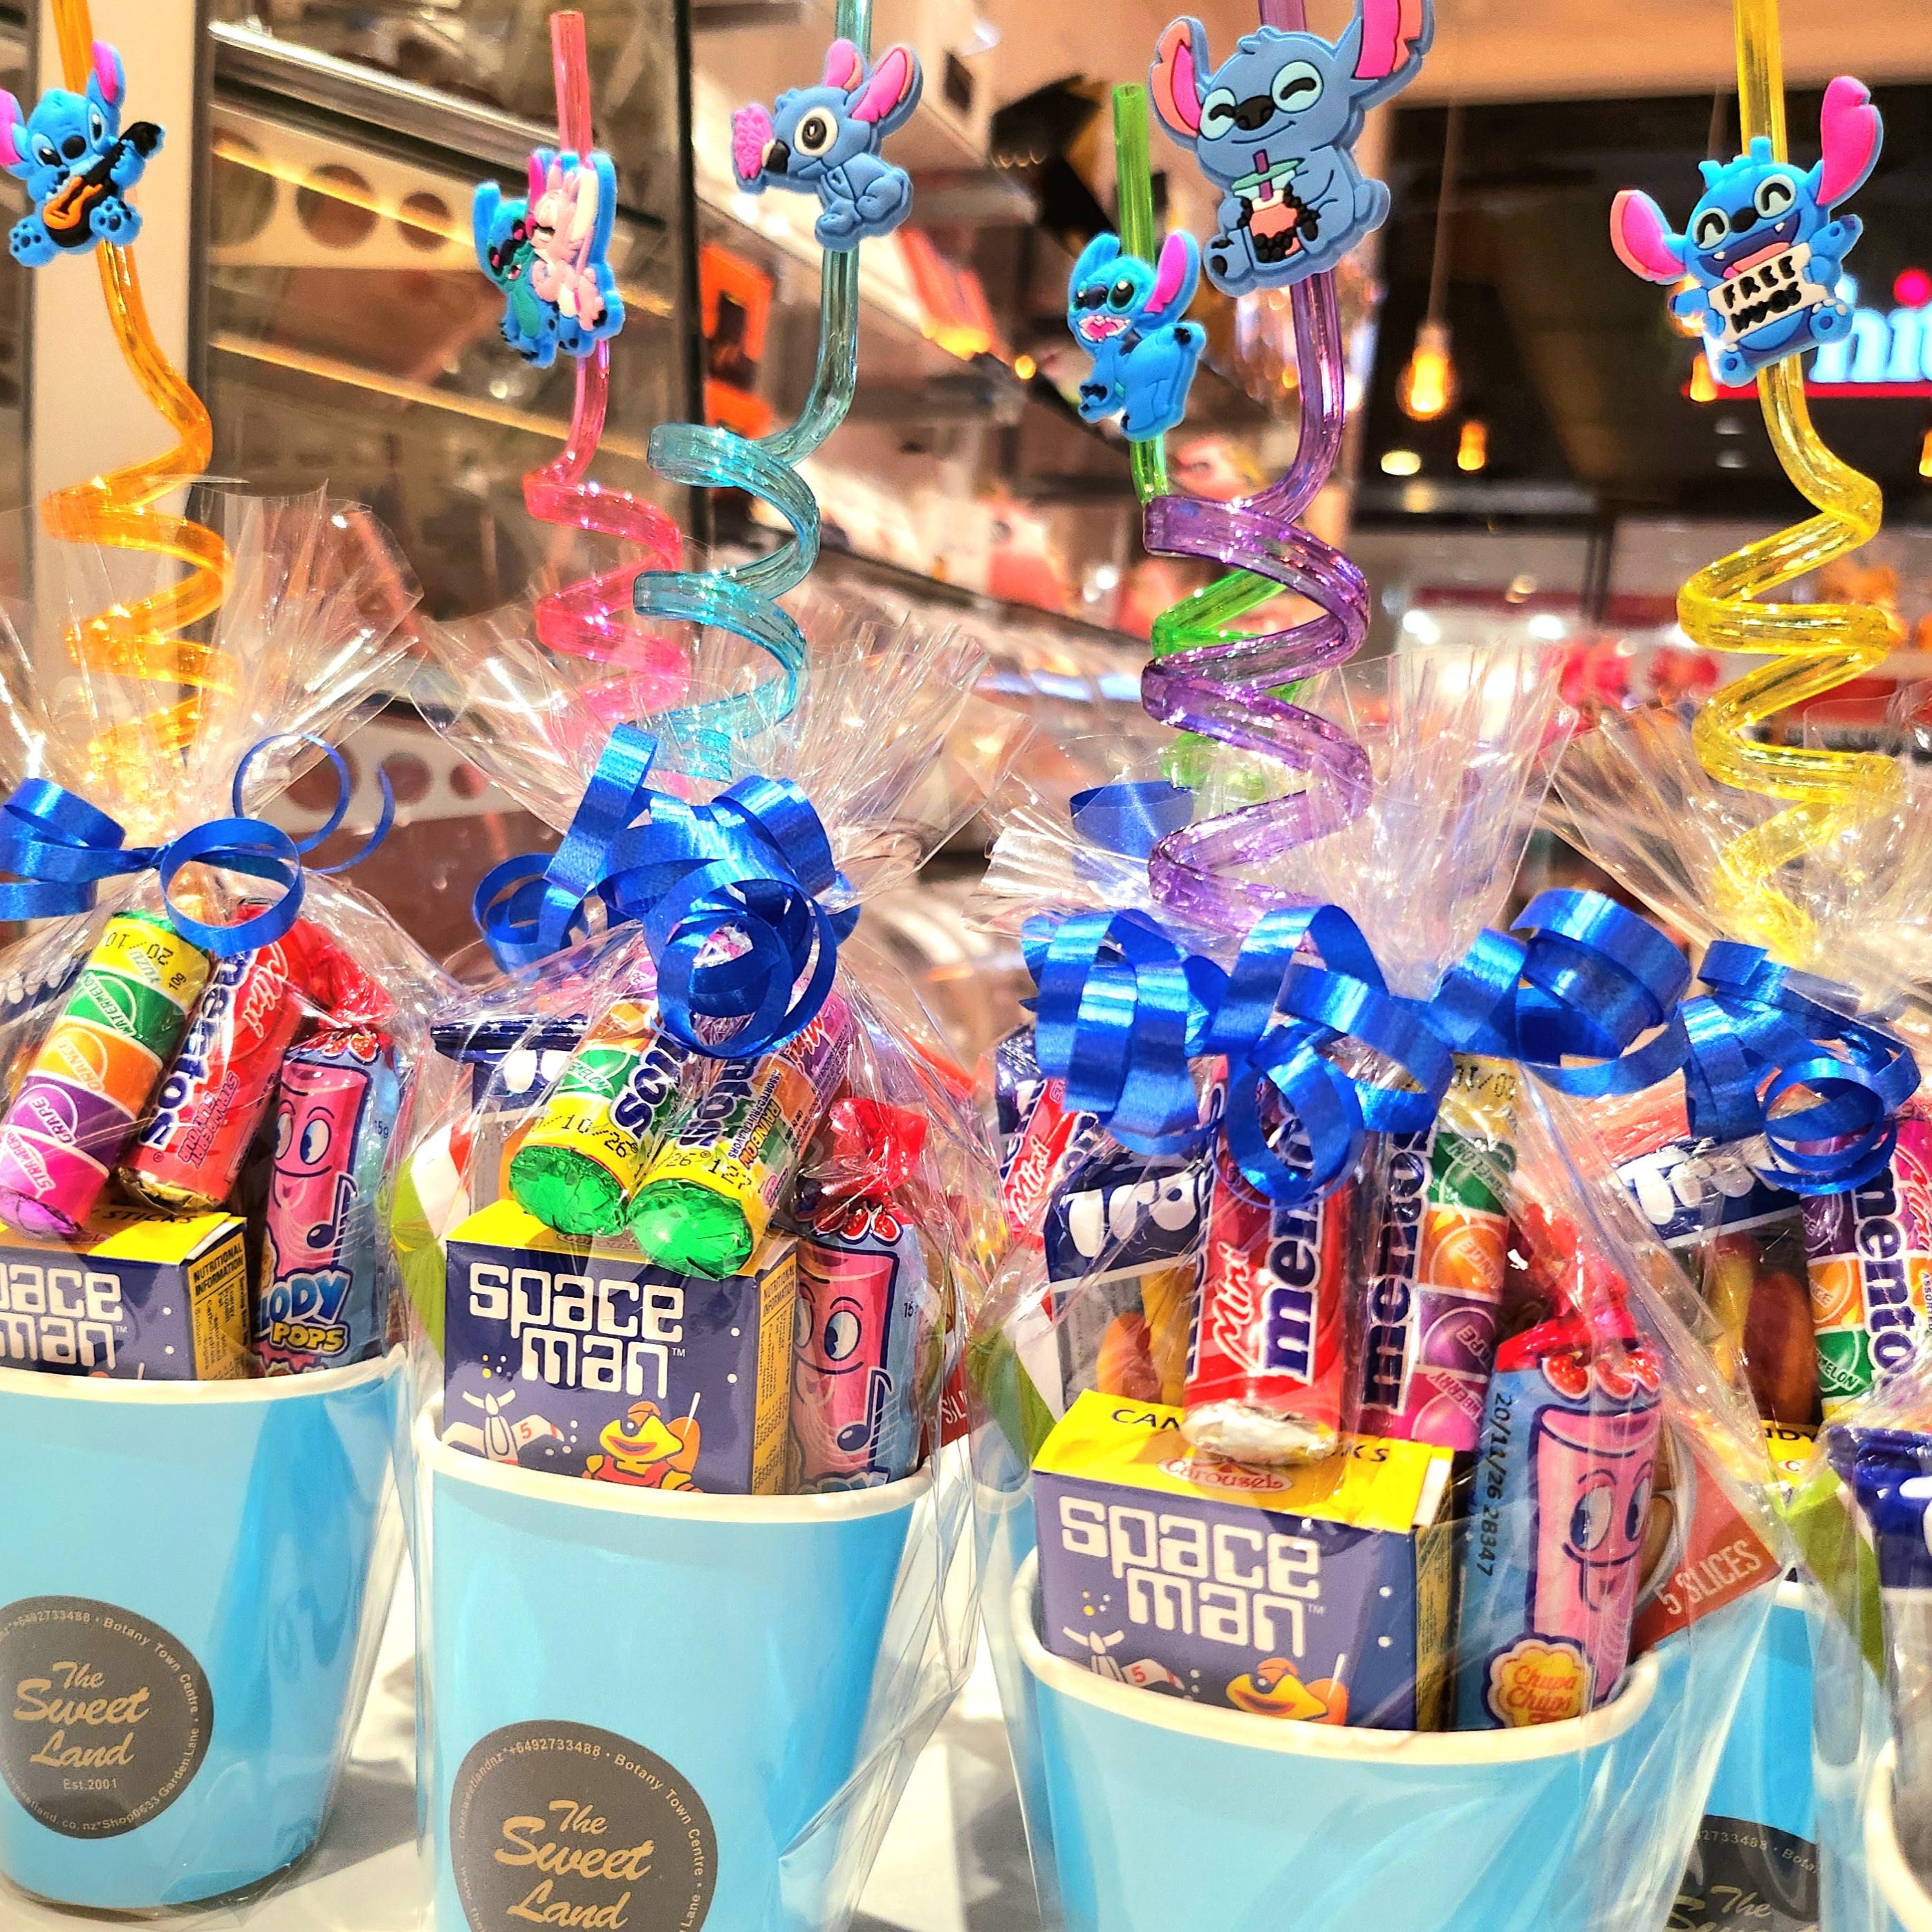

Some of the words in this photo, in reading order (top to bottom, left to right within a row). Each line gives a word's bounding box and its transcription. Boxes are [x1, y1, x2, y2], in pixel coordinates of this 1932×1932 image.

[1724, 254, 1794, 309] FREE
[1730, 281, 1802, 334] HUGS
[128, 949, 161, 984] YUZU
[167, 972, 187, 991] 10g
[757, 1069, 782, 1108] ASSORTED
[32, 1097, 74, 1144] GRAPE
[178, 1092, 219, 1163] FLAVOUR
[189, 1070, 241, 1169] STRAWBERRY
[739, 1098, 782, 1170] RAINBOW
[727, 1122, 753, 1160] FLAVORS
[1010, 1134, 1050, 1226] Mini
[104, 1210, 194, 1225] STICKS
[194, 1243, 243, 1283] NUTRITIONAL
[195, 1255, 244, 1297] INFORMATION
[763, 1264, 795, 1302] NUTRITIONAL
[1261, 1151, 1326, 1386] men
[1852, 1166, 1915, 1385] mento
[0, 1263, 123, 1321] ace
[470, 1262, 685, 1343] space
[763, 1281, 796, 1316] INFORMATION
[1212, 1241, 1262, 1377] Mini
[272, 1323, 345, 1351] POPS
[521, 1327, 669, 1399] man
[520, 1422, 532, 1439] 5
[1111, 1408, 1182, 1432] CAN
[1485, 1392, 1513, 1500] 20/11/26
[1165, 1456, 1285, 1490] Carousel
[1059, 1495, 1321, 1599] space
[1654, 1581, 1682, 1616] 5
[1674, 1539, 1763, 1604] SLICES
[1126, 1567, 1304, 1657] man
[52, 1661, 105, 1689] The
[104, 1617, 151, 1646] Botany
[154, 1642, 181, 1672] Town
[179, 1673, 198, 1713] Centre
[1131, 1666, 1148, 1684] 5
[1512, 1664, 1577, 1690] Chupa
[13, 1678, 150, 1726] Sweet
[1506, 1684, 1572, 1711] Chups
[29, 1729, 135, 1768] Land
[159, 1758, 190, 1796] Garden
[183, 1727, 199, 1757] Lane
[509, 1738, 601, 1757] +6492733488
[614, 1754, 663, 1790] Botany
[548, 1799, 608, 1835] The
[665, 1788, 692, 1825] Town
[494, 1816, 654, 1881] Sweet
[687, 1828, 704, 1876] Centre
[506, 1879, 631, 1929] Land
[681, 1895, 701, 1926] Lane
[1709, 1885, 1772, 1918] The
